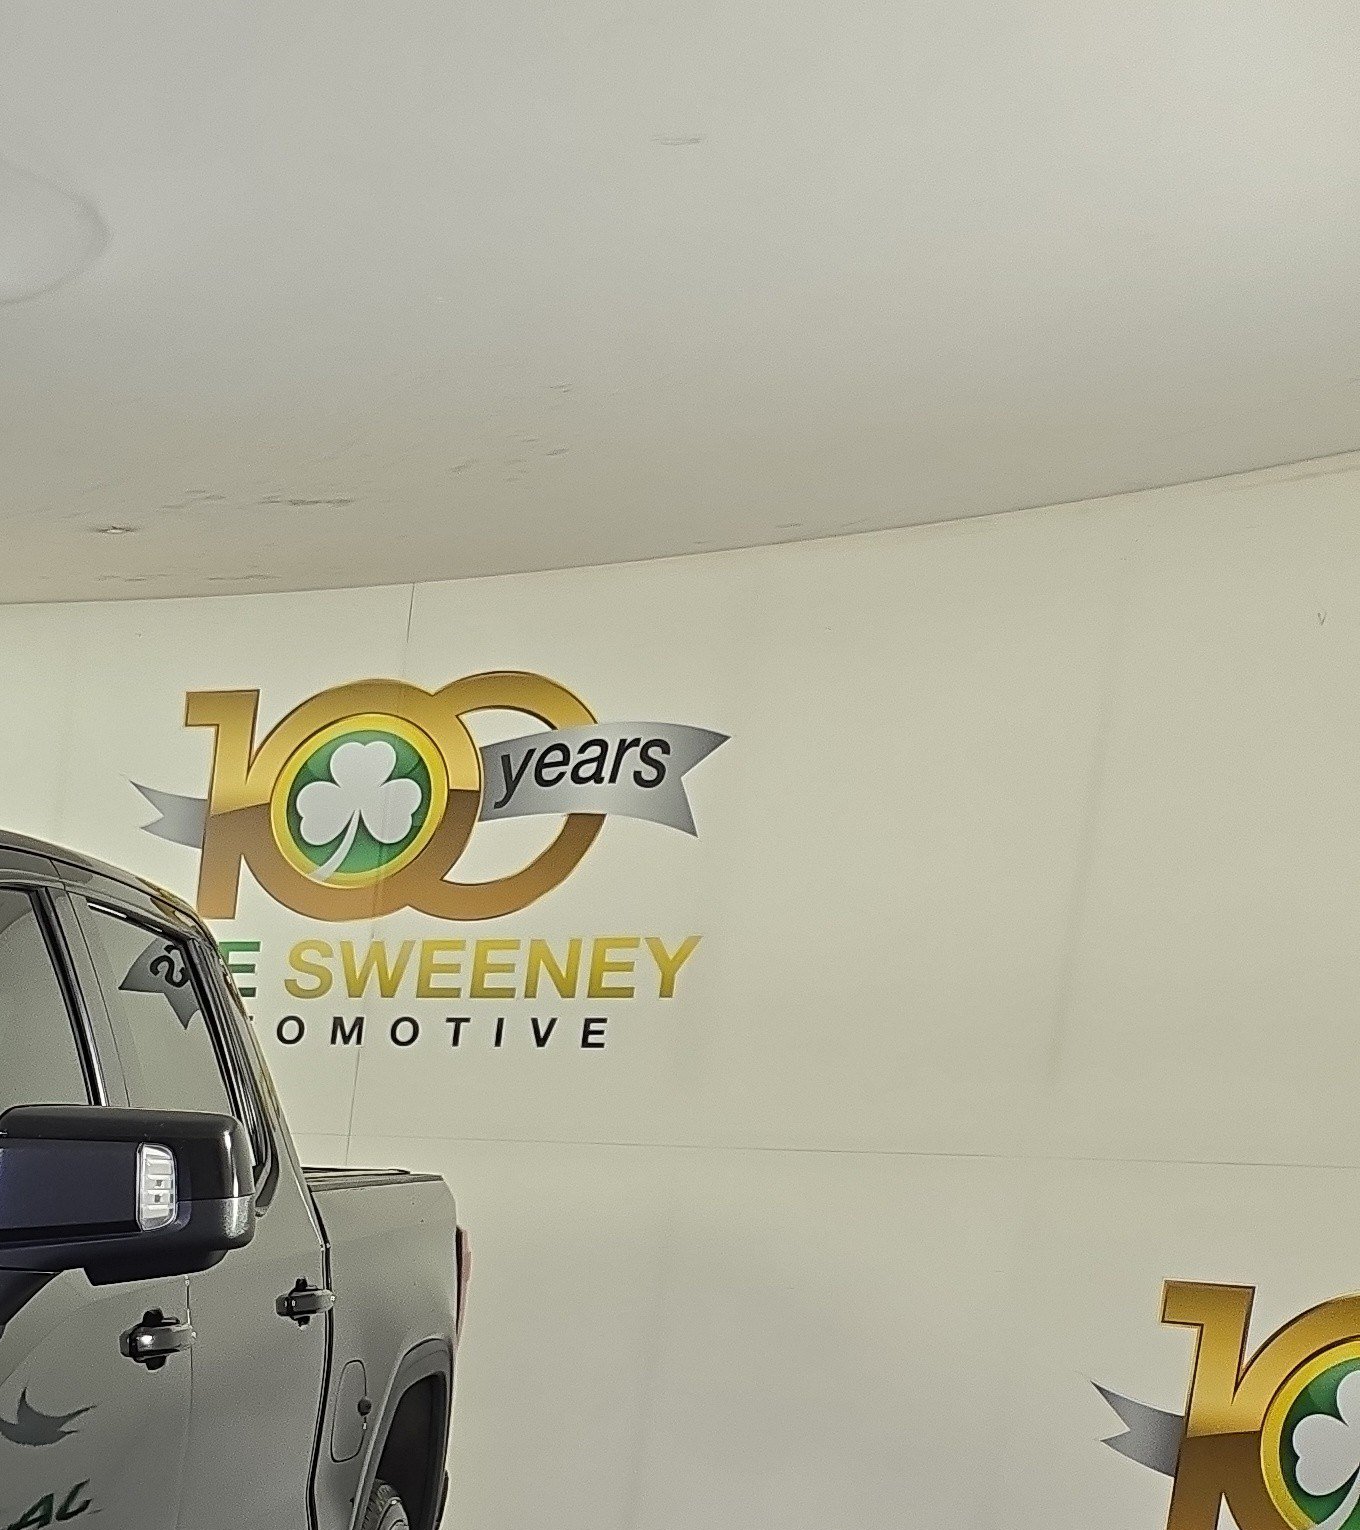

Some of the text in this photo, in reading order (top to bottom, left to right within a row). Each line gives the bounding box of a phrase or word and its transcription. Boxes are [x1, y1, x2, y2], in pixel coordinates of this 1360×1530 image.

[185, 671, 606, 922] 100
[493, 735, 670, 810] years
[283, 935, 702, 1001] SWEENEY
[276, 1015, 609, 1049] OMOTIVE
